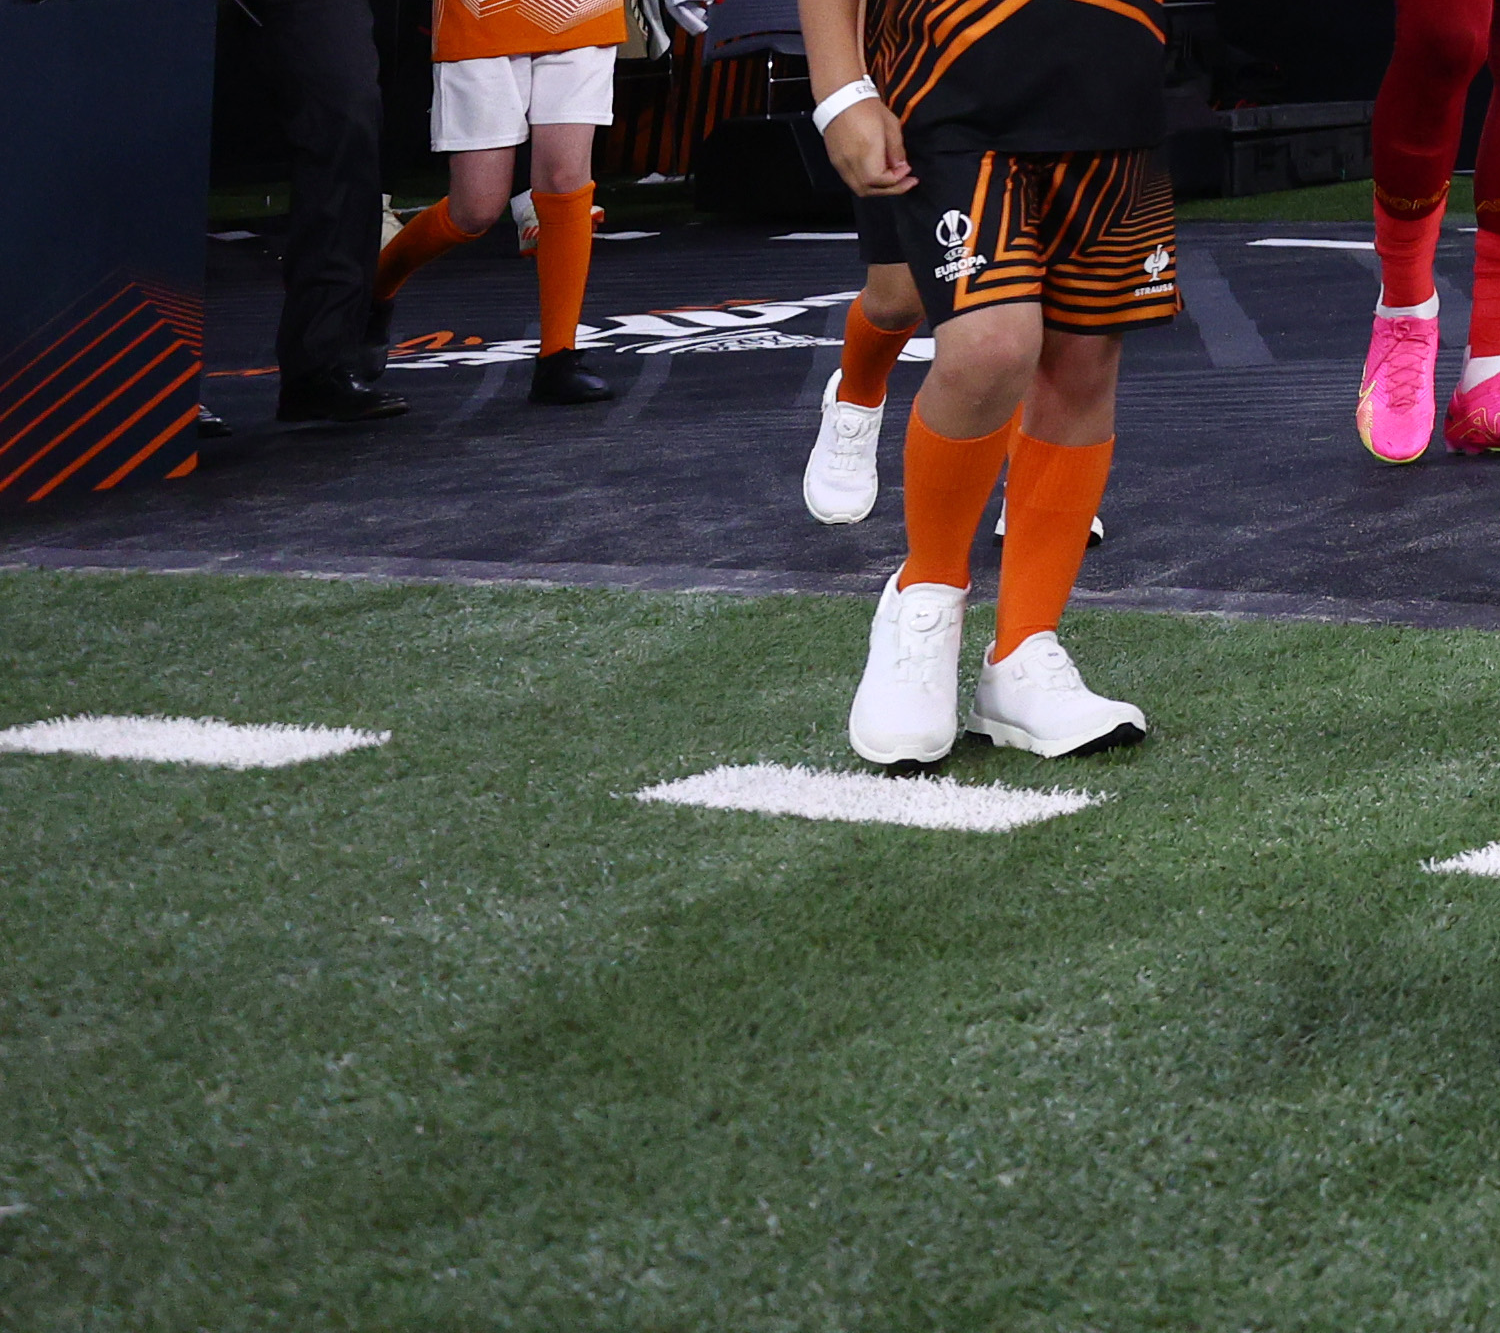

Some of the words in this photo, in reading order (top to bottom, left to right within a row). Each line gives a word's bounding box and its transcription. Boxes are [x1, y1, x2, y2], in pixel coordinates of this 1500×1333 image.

[934, 254, 988, 280] EUROPA
[944, 266, 977, 283] LEAGUE
[1134, 281, 1175, 298] STRAUSS
